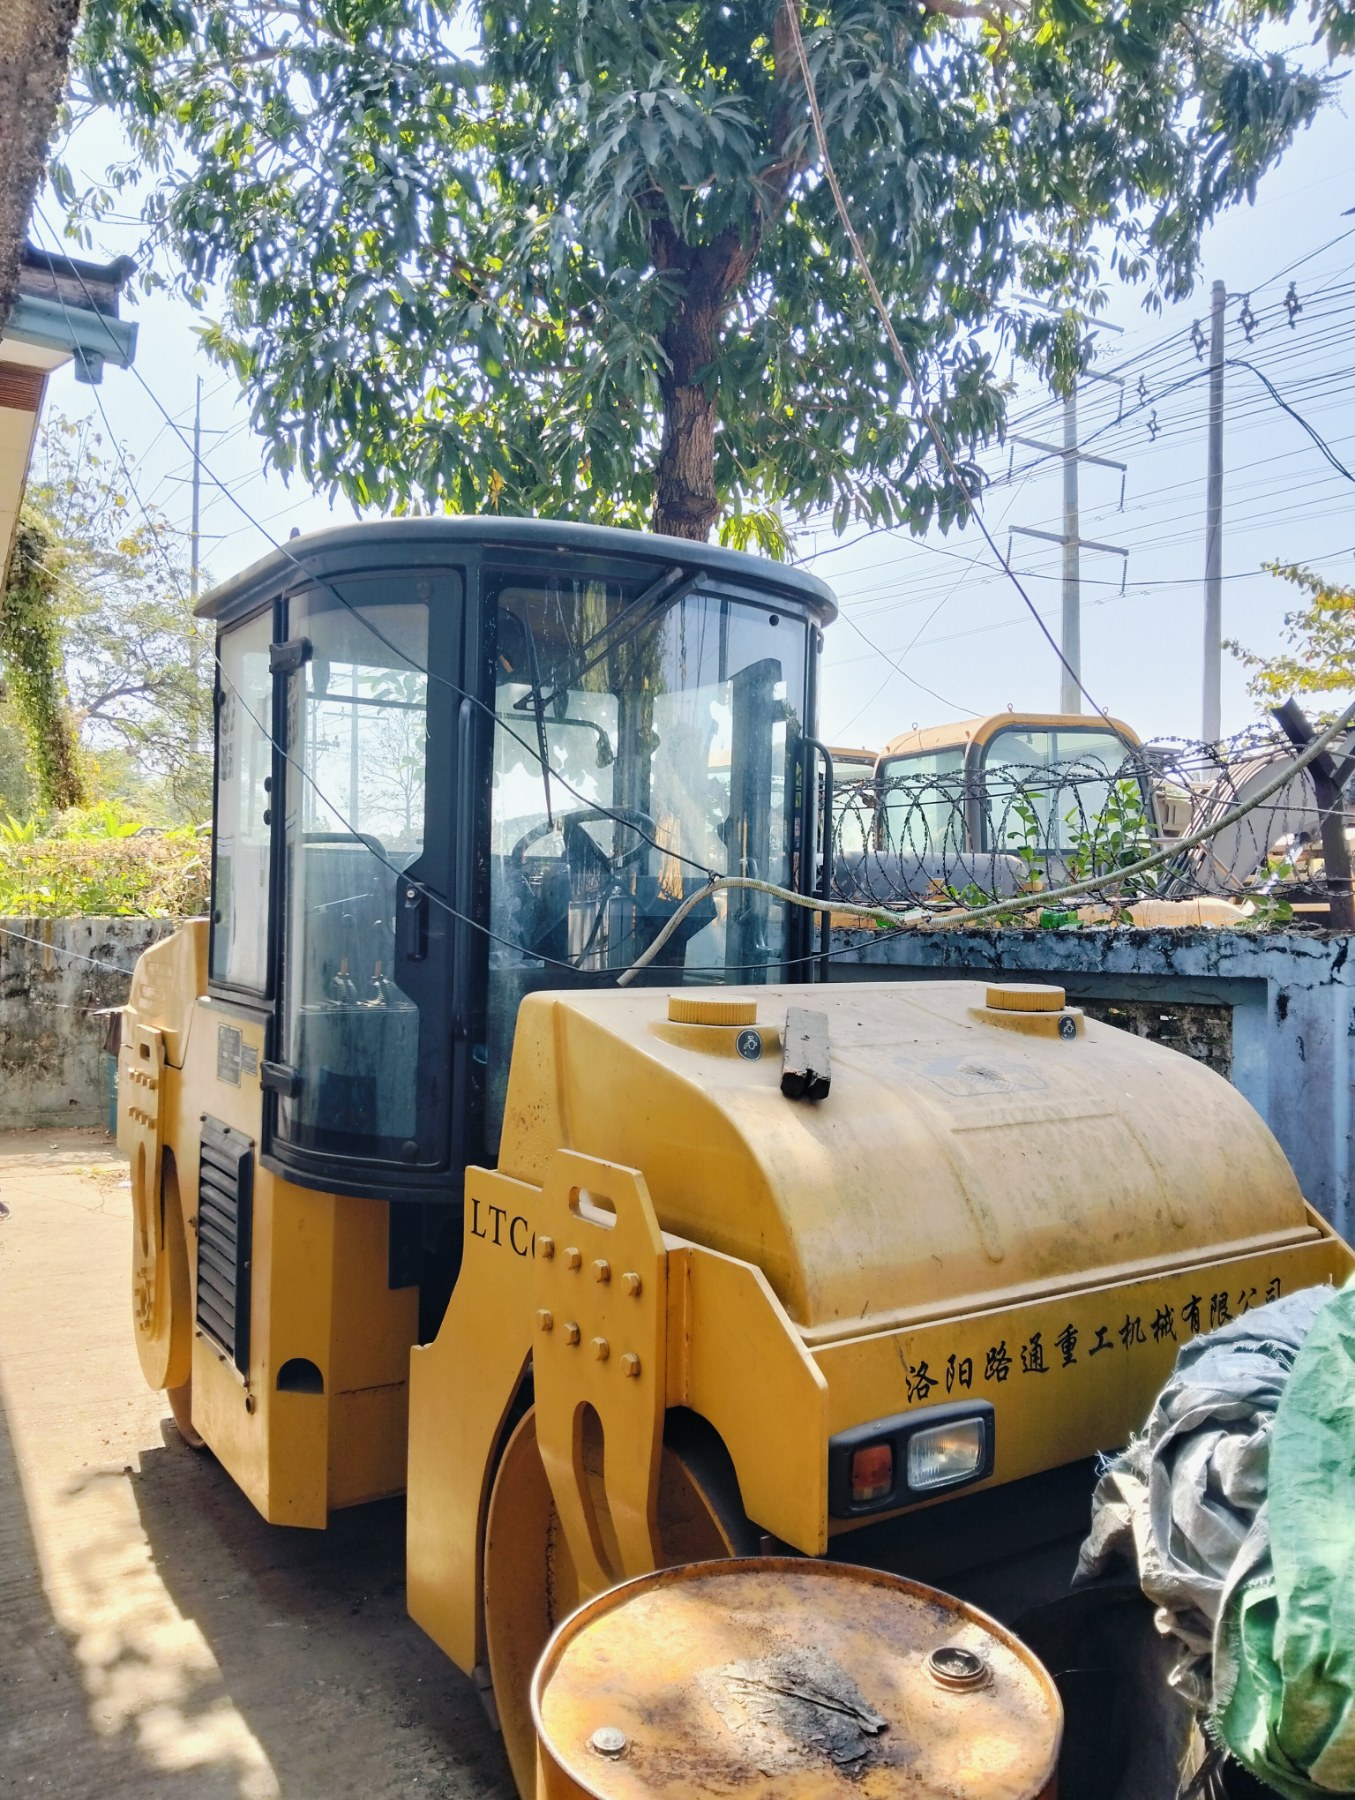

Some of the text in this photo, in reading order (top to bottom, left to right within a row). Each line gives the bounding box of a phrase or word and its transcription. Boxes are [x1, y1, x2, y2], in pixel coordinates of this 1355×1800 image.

[470, 1198, 536, 1259] LTC
[905, 1277, 1281, 1403] 洛阳路通重工机械有限公司
